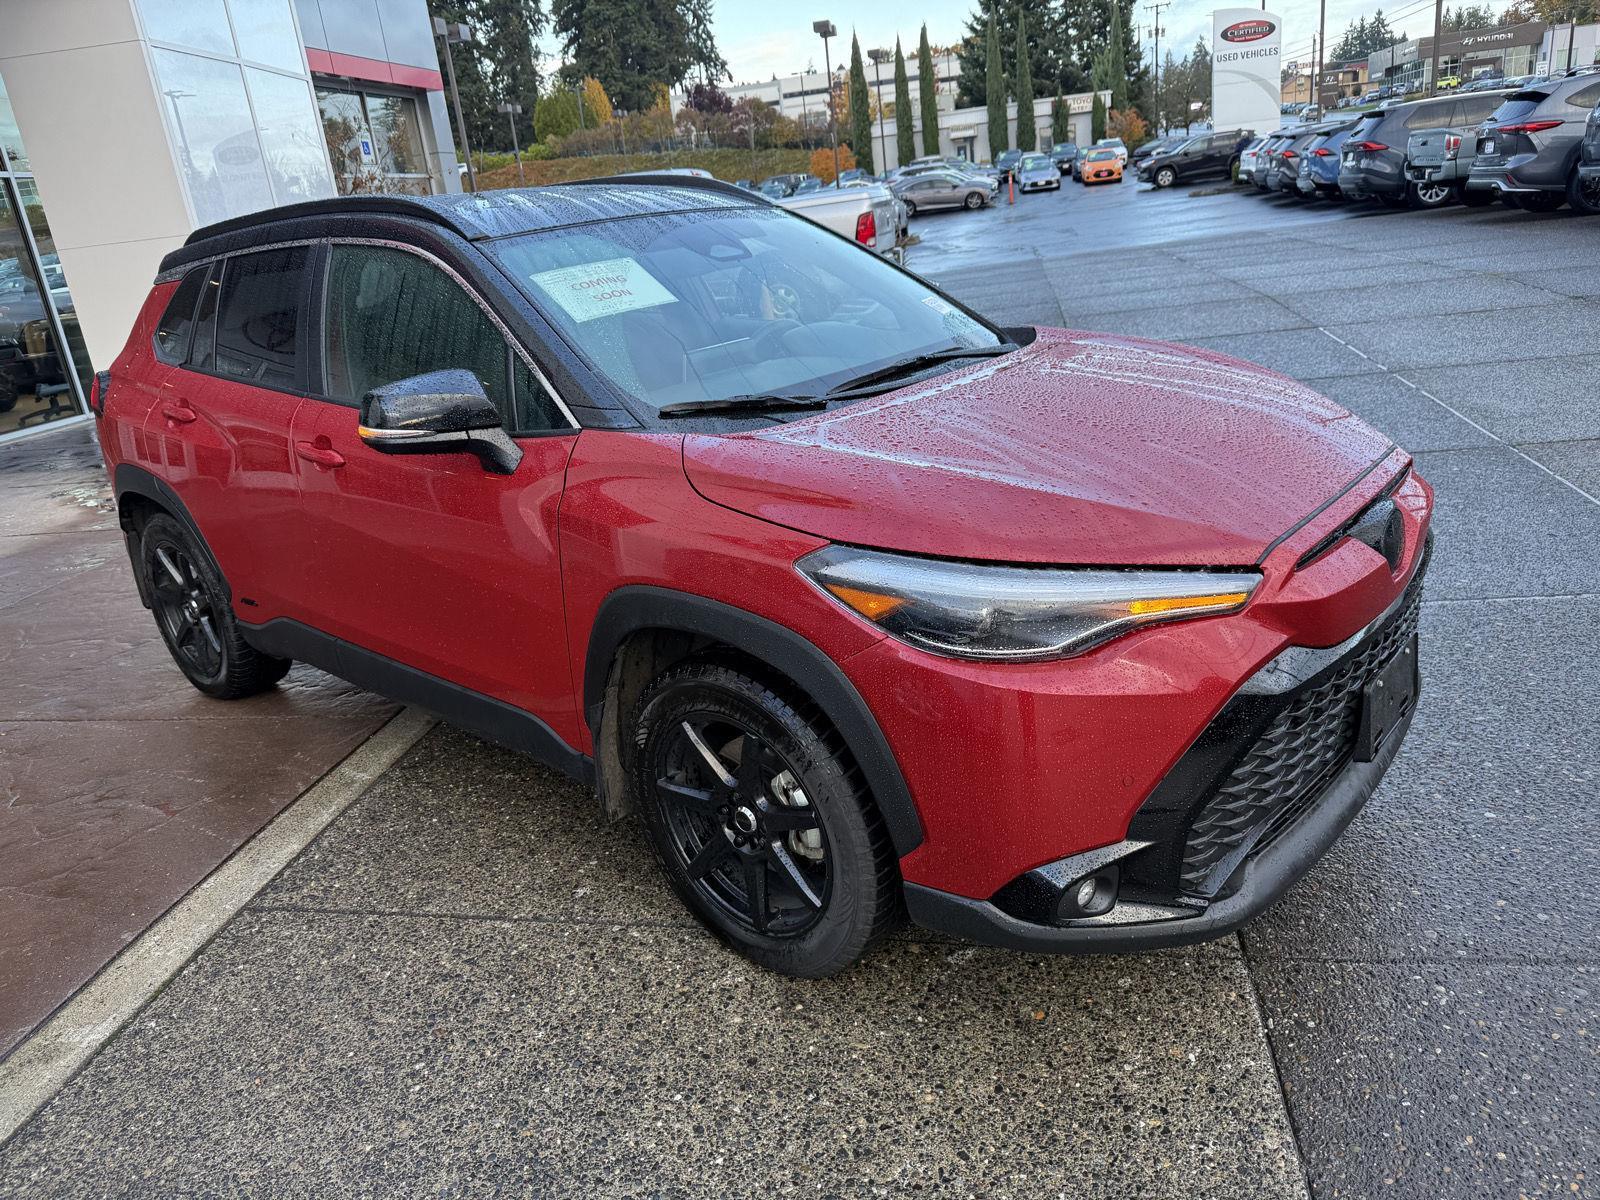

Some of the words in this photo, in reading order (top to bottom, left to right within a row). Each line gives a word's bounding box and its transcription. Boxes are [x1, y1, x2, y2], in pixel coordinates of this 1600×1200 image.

[1227, 25, 1270, 37] CERTIFIED
[1477, 32, 1514, 43] HYUNDAI
[1216, 52, 1239, 62] USED
[1240, 47, 1279, 59] VEHICLES
[1071, 96, 1092, 106] TOYO
[571, 274, 628, 291] COMING
[593, 288, 633, 302] SOON
